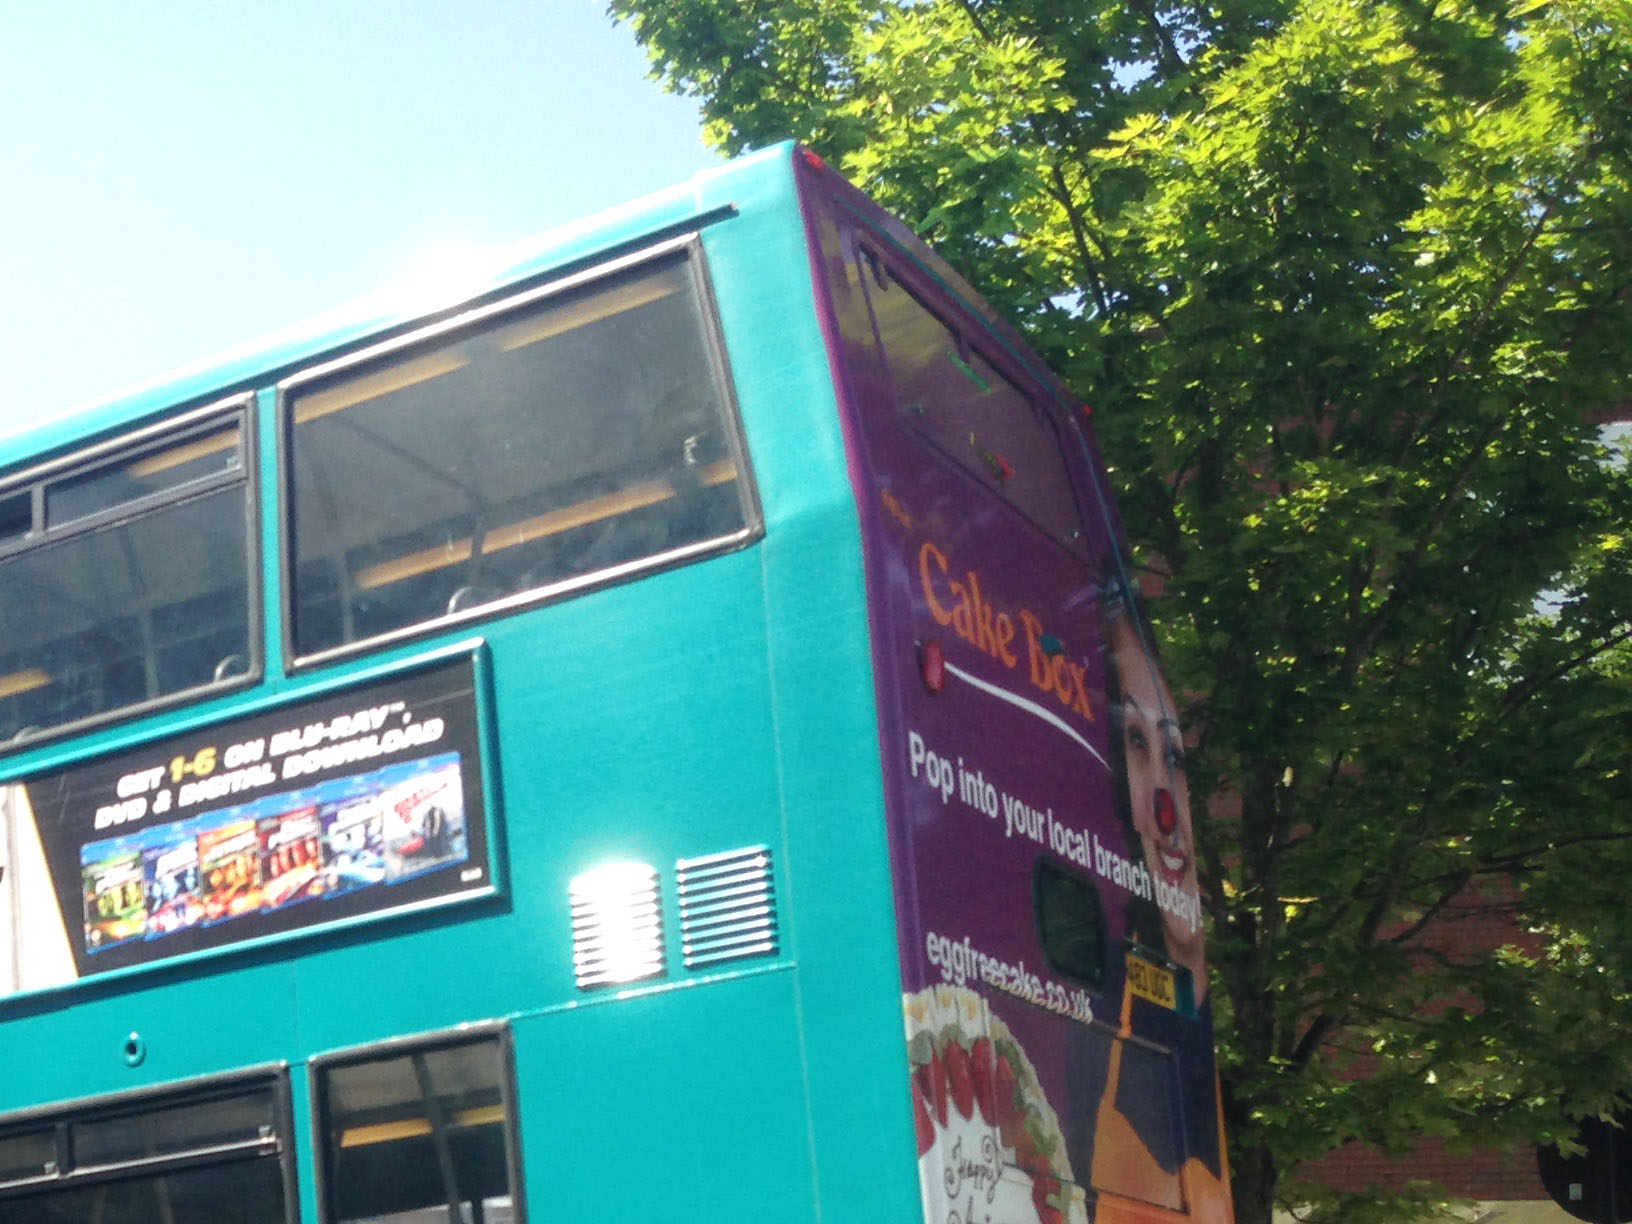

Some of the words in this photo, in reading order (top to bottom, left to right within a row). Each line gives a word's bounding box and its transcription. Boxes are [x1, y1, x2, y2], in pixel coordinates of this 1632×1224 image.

[919, 542, 1018, 669] Cake
[1019, 609, 1095, 722] Box
[94, 795, 148, 830] DVD
[153, 790, 172, 814] &
[178, 762, 277, 808] DIGITAL
[282, 717, 445, 780] DOWNLOAD
[117, 765, 166, 798] GET
[169, 746, 218, 783] 1-6
[224, 739, 265, 768] ON
[908, 730, 954, 804] Pop
[958, 757, 998, 819] into
[1002, 792, 1045, 838] your
[1048, 808, 1091, 870] local
[1094, 834, 1152, 902] branch
[1153, 870, 1204, 935] today!
